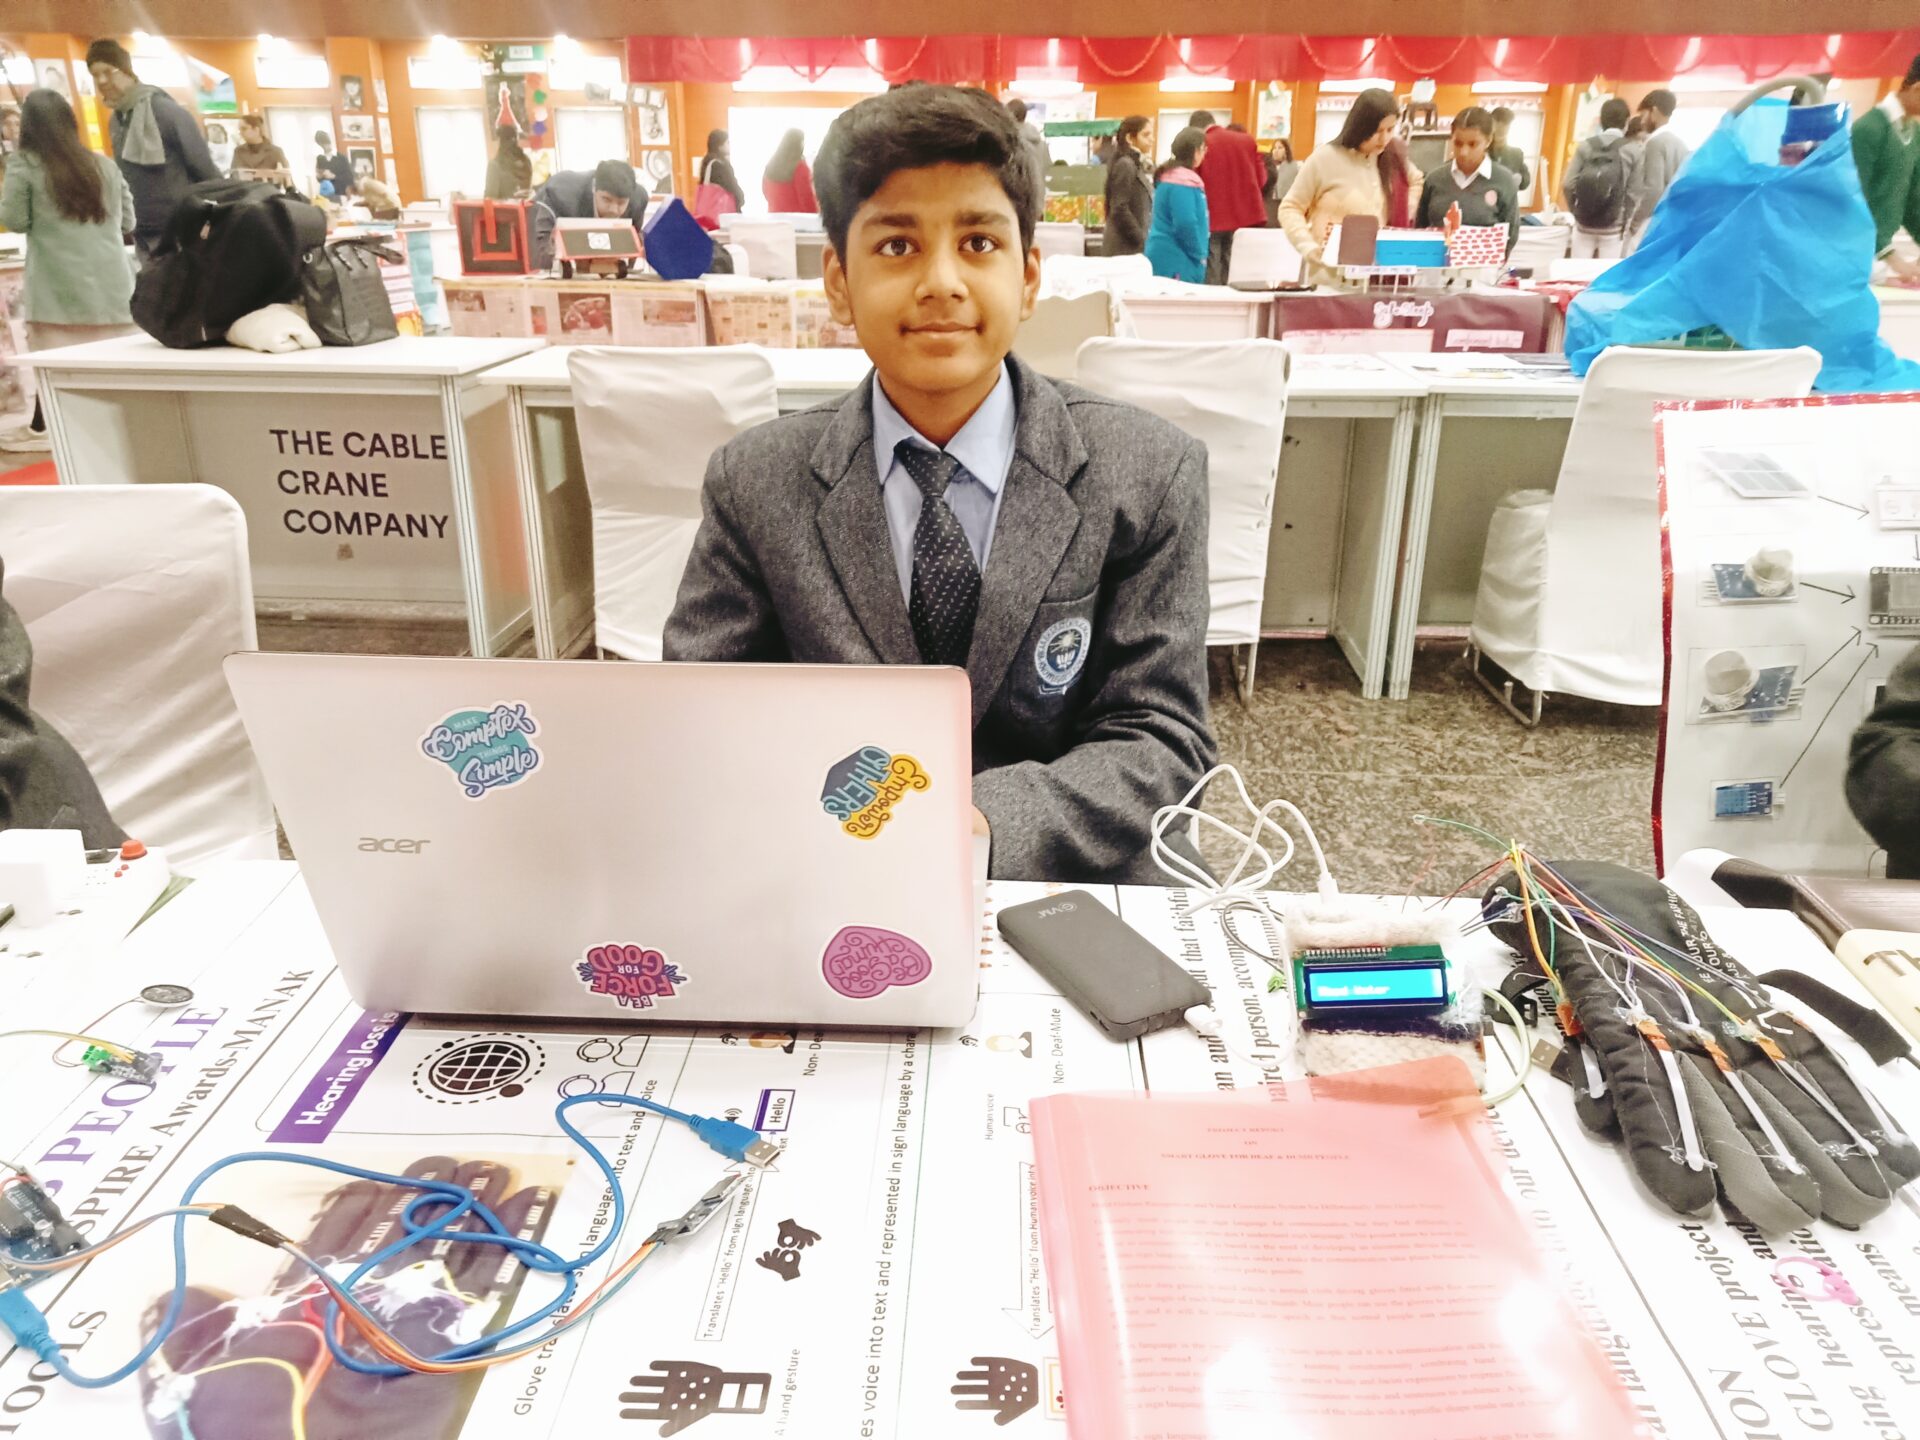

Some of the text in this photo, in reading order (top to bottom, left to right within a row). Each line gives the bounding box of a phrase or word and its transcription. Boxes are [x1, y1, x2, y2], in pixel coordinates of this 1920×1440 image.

[270, 430, 448, 460] THE CABLE
[277, 469, 389, 498] CRANE
[284, 509, 449, 539] COMPANY
[423, 704, 536, 762] Complex
[459, 744, 539, 797] Simple
[823, 746, 893, 821] OTHERS
[846, 758, 928, 838] Empower
[358, 837, 431, 854] acer
[587, 944, 665, 977] GOOD
[892, 948, 924, 980] Be
[1180, 938, 1202, 962] that
[591, 972, 675, 997] FORCE
[617, 965, 640, 975] FOR
[632, 995, 653, 1009] BE
[151, 969, 314, 1137] Awards-MANAK
[903, 1059, 913, 1067] a
[294, 1057, 374, 1125] Hearing
[346, 1024, 389, 1055] loss
[898, 1068, 916, 1081] by
[1214, 1071, 1235, 1092] an
[769, 1097, 786, 1123] Hello
[892, 1084, 914, 1133] language
[891, 1136, 908, 1158] sign
[888, 1161, 902, 1173] in
[880, 1178, 901, 1254] represented
[1029, 1199, 1039, 1230] Human
[1030, 1231, 1039, 1251] from
[514, 1366, 547, 1416] Glove
[618, 1134, 638, 1157] text
[630, 1111, 646, 1131] and
[875, 1261, 892, 1287] and
[704, 1291, 726, 1338] Translates
[724, 1236, 738, 1257] from
[871, 1292, 888, 1321] text
[1029, 1281, 1041, 1332] Translates
[865, 1325, 884, 1358] into
[1678, 1222, 1834, 1432] GLOVE project
[784, 1348, 801, 1391] gesture
[861, 1364, 880, 1411] voice
